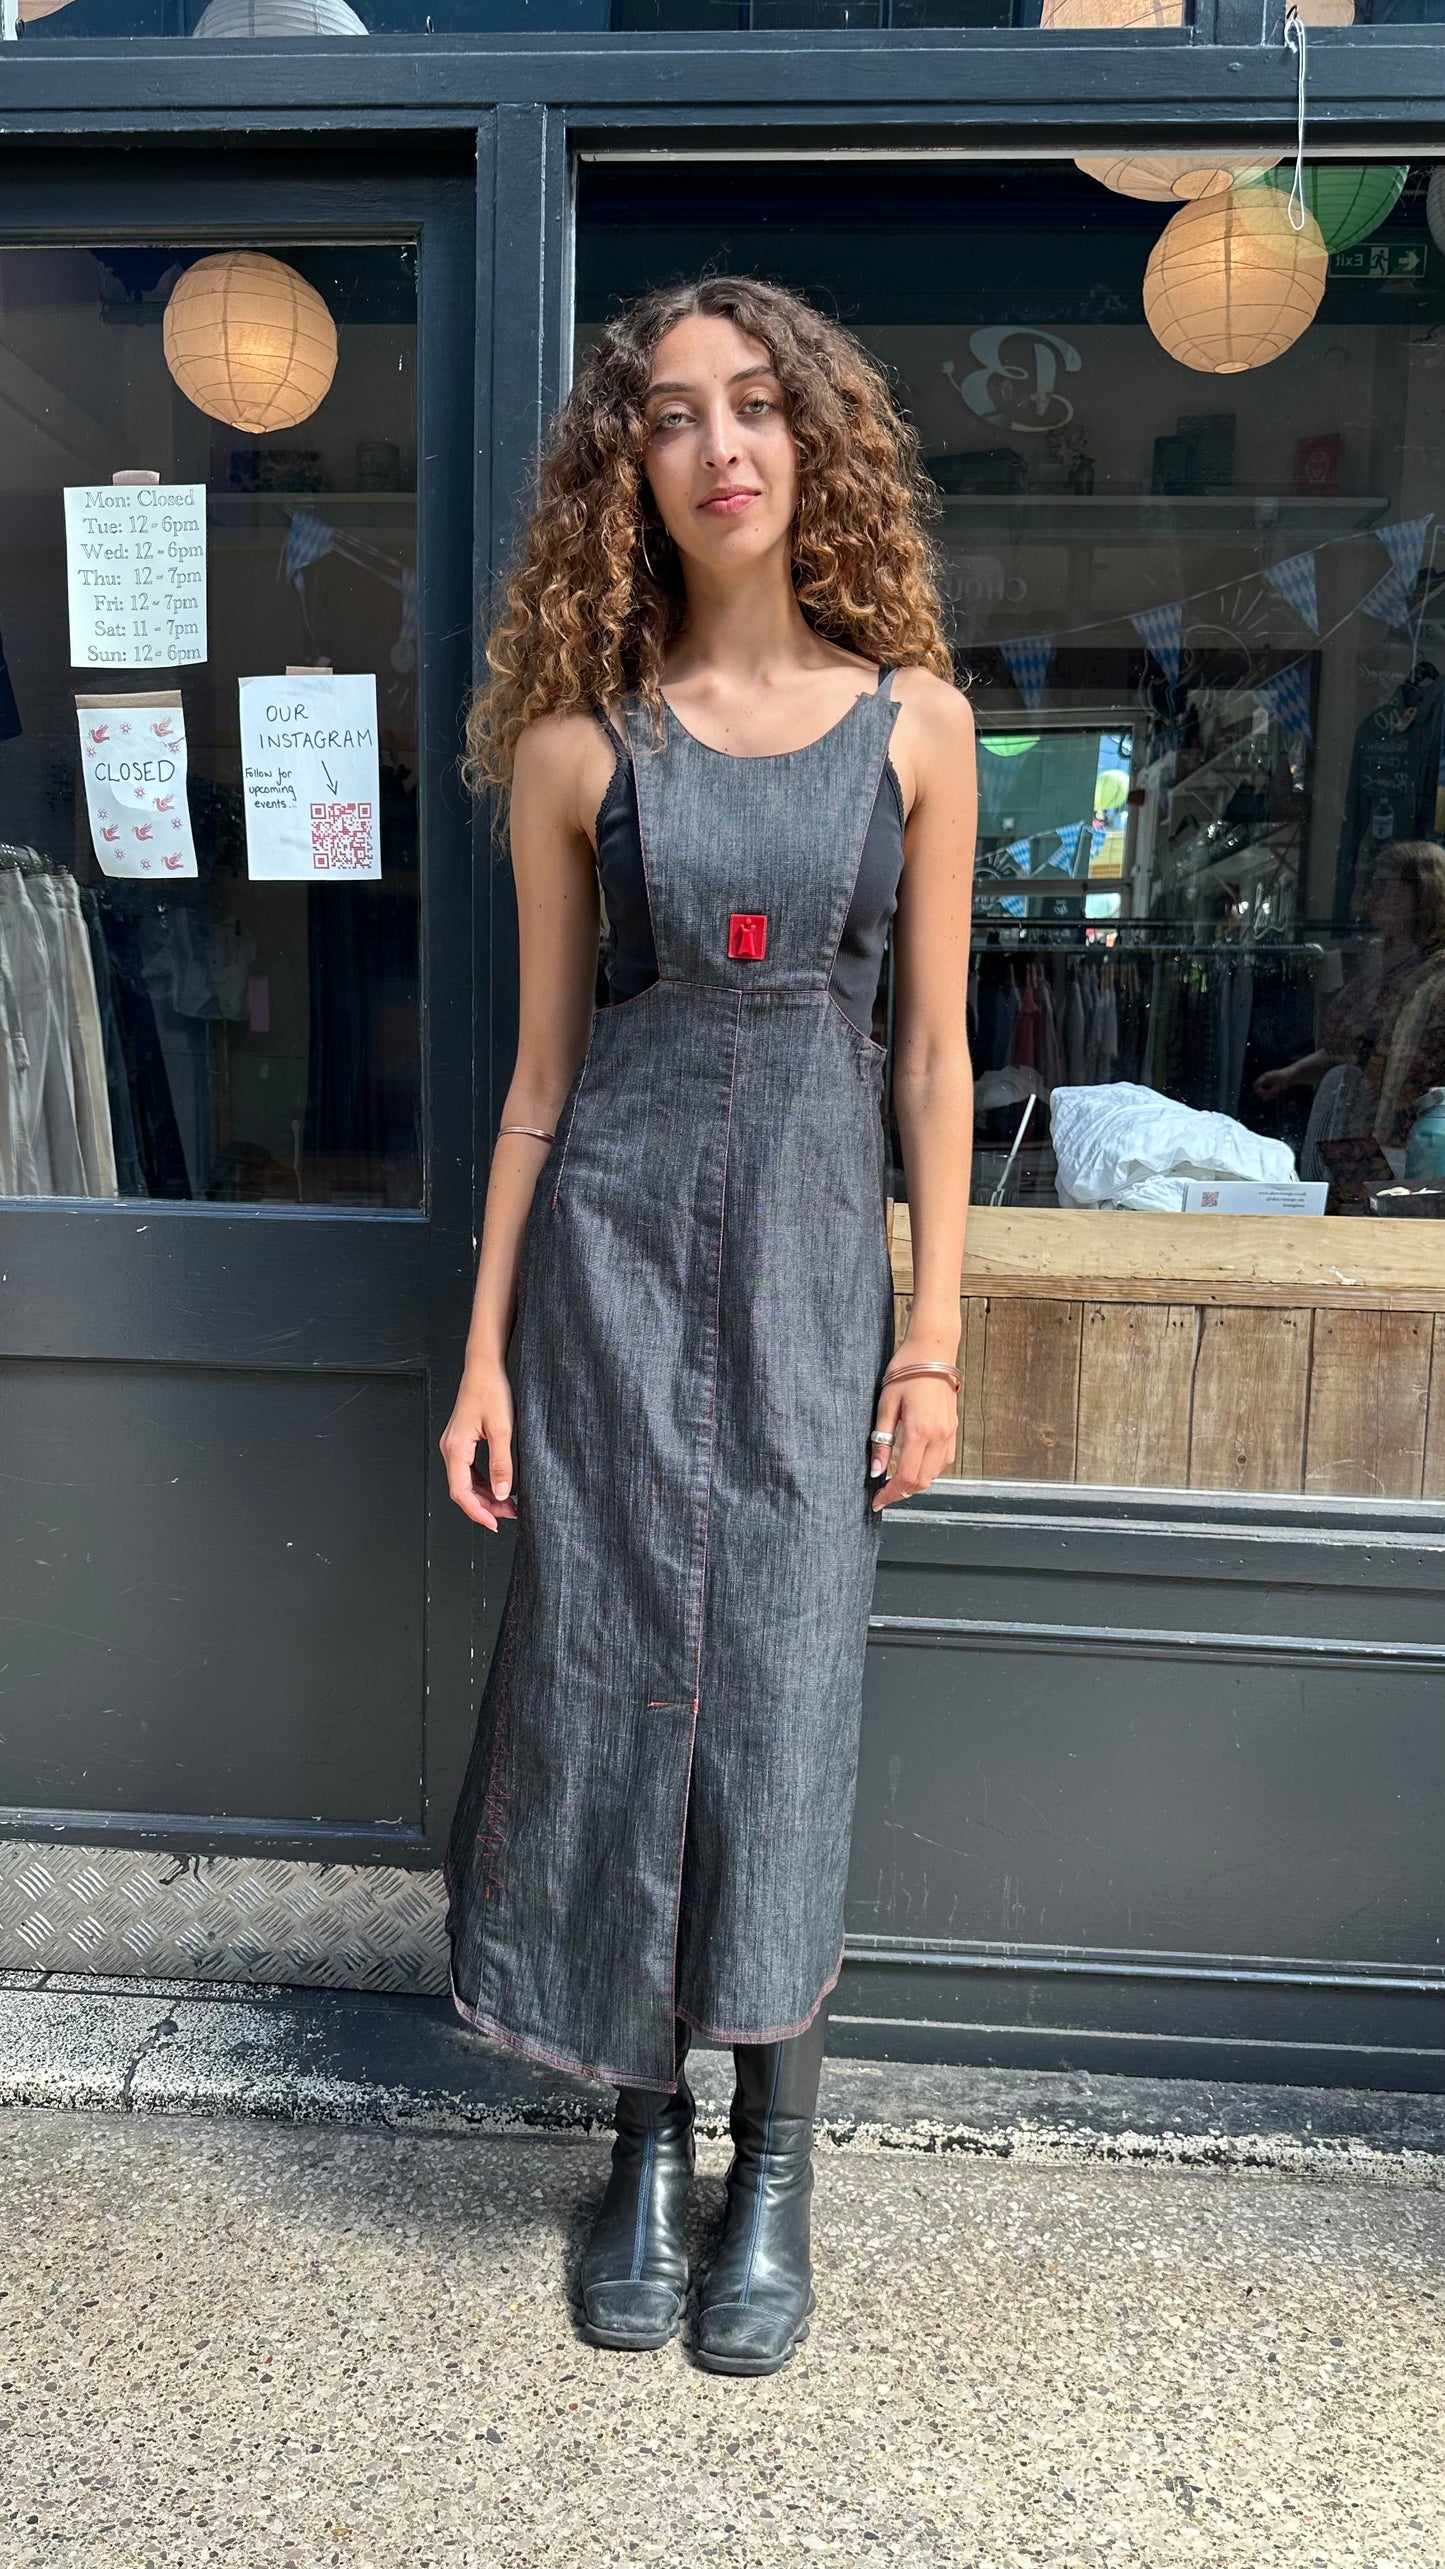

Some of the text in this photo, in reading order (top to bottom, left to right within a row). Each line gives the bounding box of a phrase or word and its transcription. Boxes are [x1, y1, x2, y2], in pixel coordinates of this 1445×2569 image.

[85, 489, 195, 508] Mon: Closed
[83, 516, 123, 534] Tue:
[80, 543, 129, 560] Wed:
[77, 569, 122, 586] Thu:
[93, 594, 124, 611] Fri:
[94, 620, 126, 637] Sat:
[87, 645, 127, 662] Sun:
[266, 703, 309, 724] OUR
[259, 728, 374, 749] INSTAGRAM
[94, 759, 176, 783] CLOSED
[245, 767, 292, 786] Follow for
[249, 785, 297, 801] upcoming
